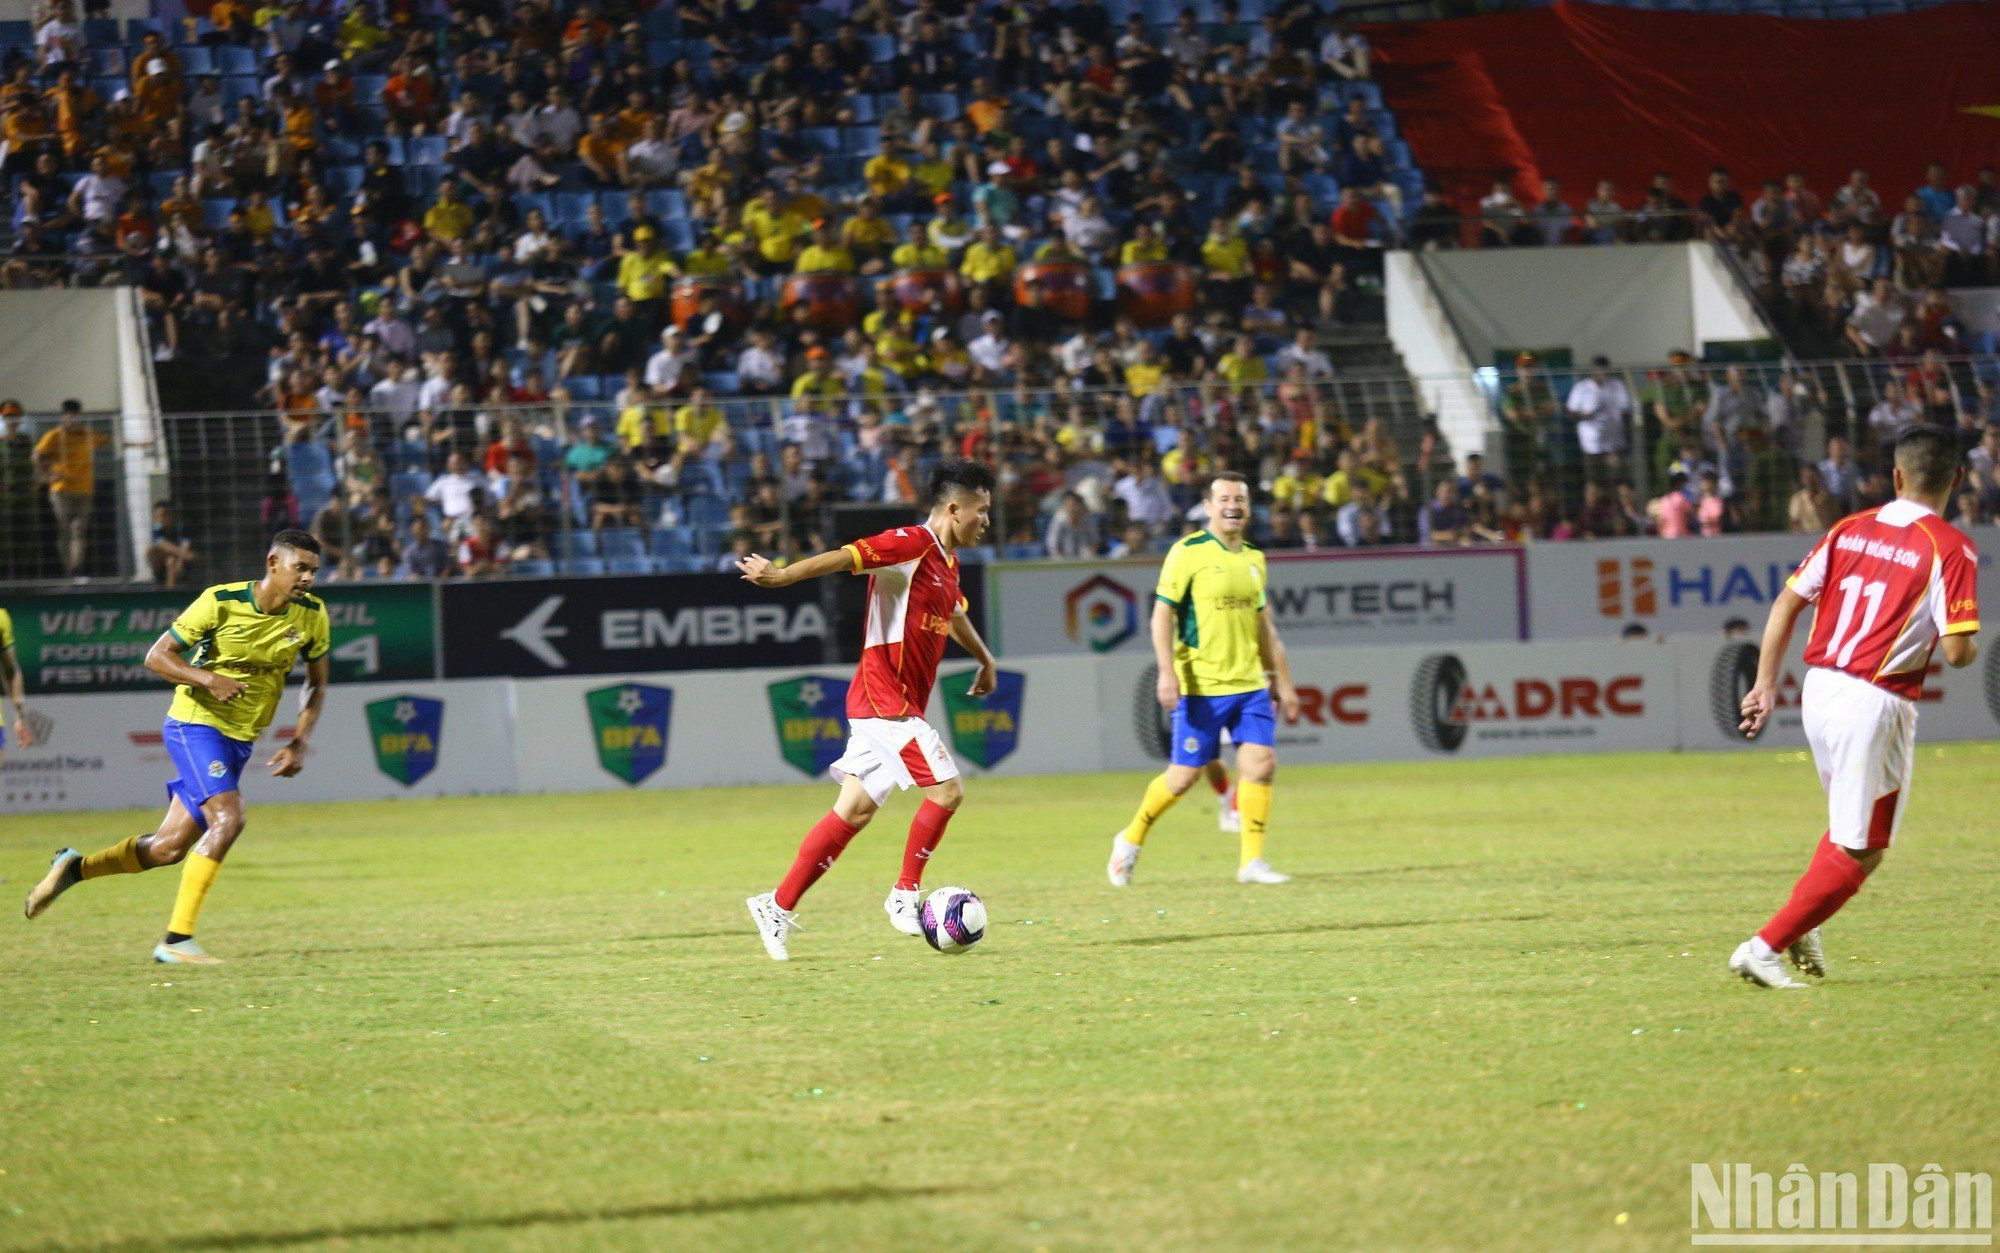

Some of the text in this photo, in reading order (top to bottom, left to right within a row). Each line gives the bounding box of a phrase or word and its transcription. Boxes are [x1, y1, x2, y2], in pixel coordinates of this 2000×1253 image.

[1266, 580, 1456, 614] WTECH
[601, 602, 826, 649] EMBRA
[1824, 574, 1887, 668] 11
[1285, 684, 1370, 727] RC
[1513, 673, 1644, 719] DRC
[602, 726, 662, 750] BFA
[784, 717, 843, 740] BFA
[955, 711, 1013, 733] BFA
[381, 733, 434, 753] BFA
